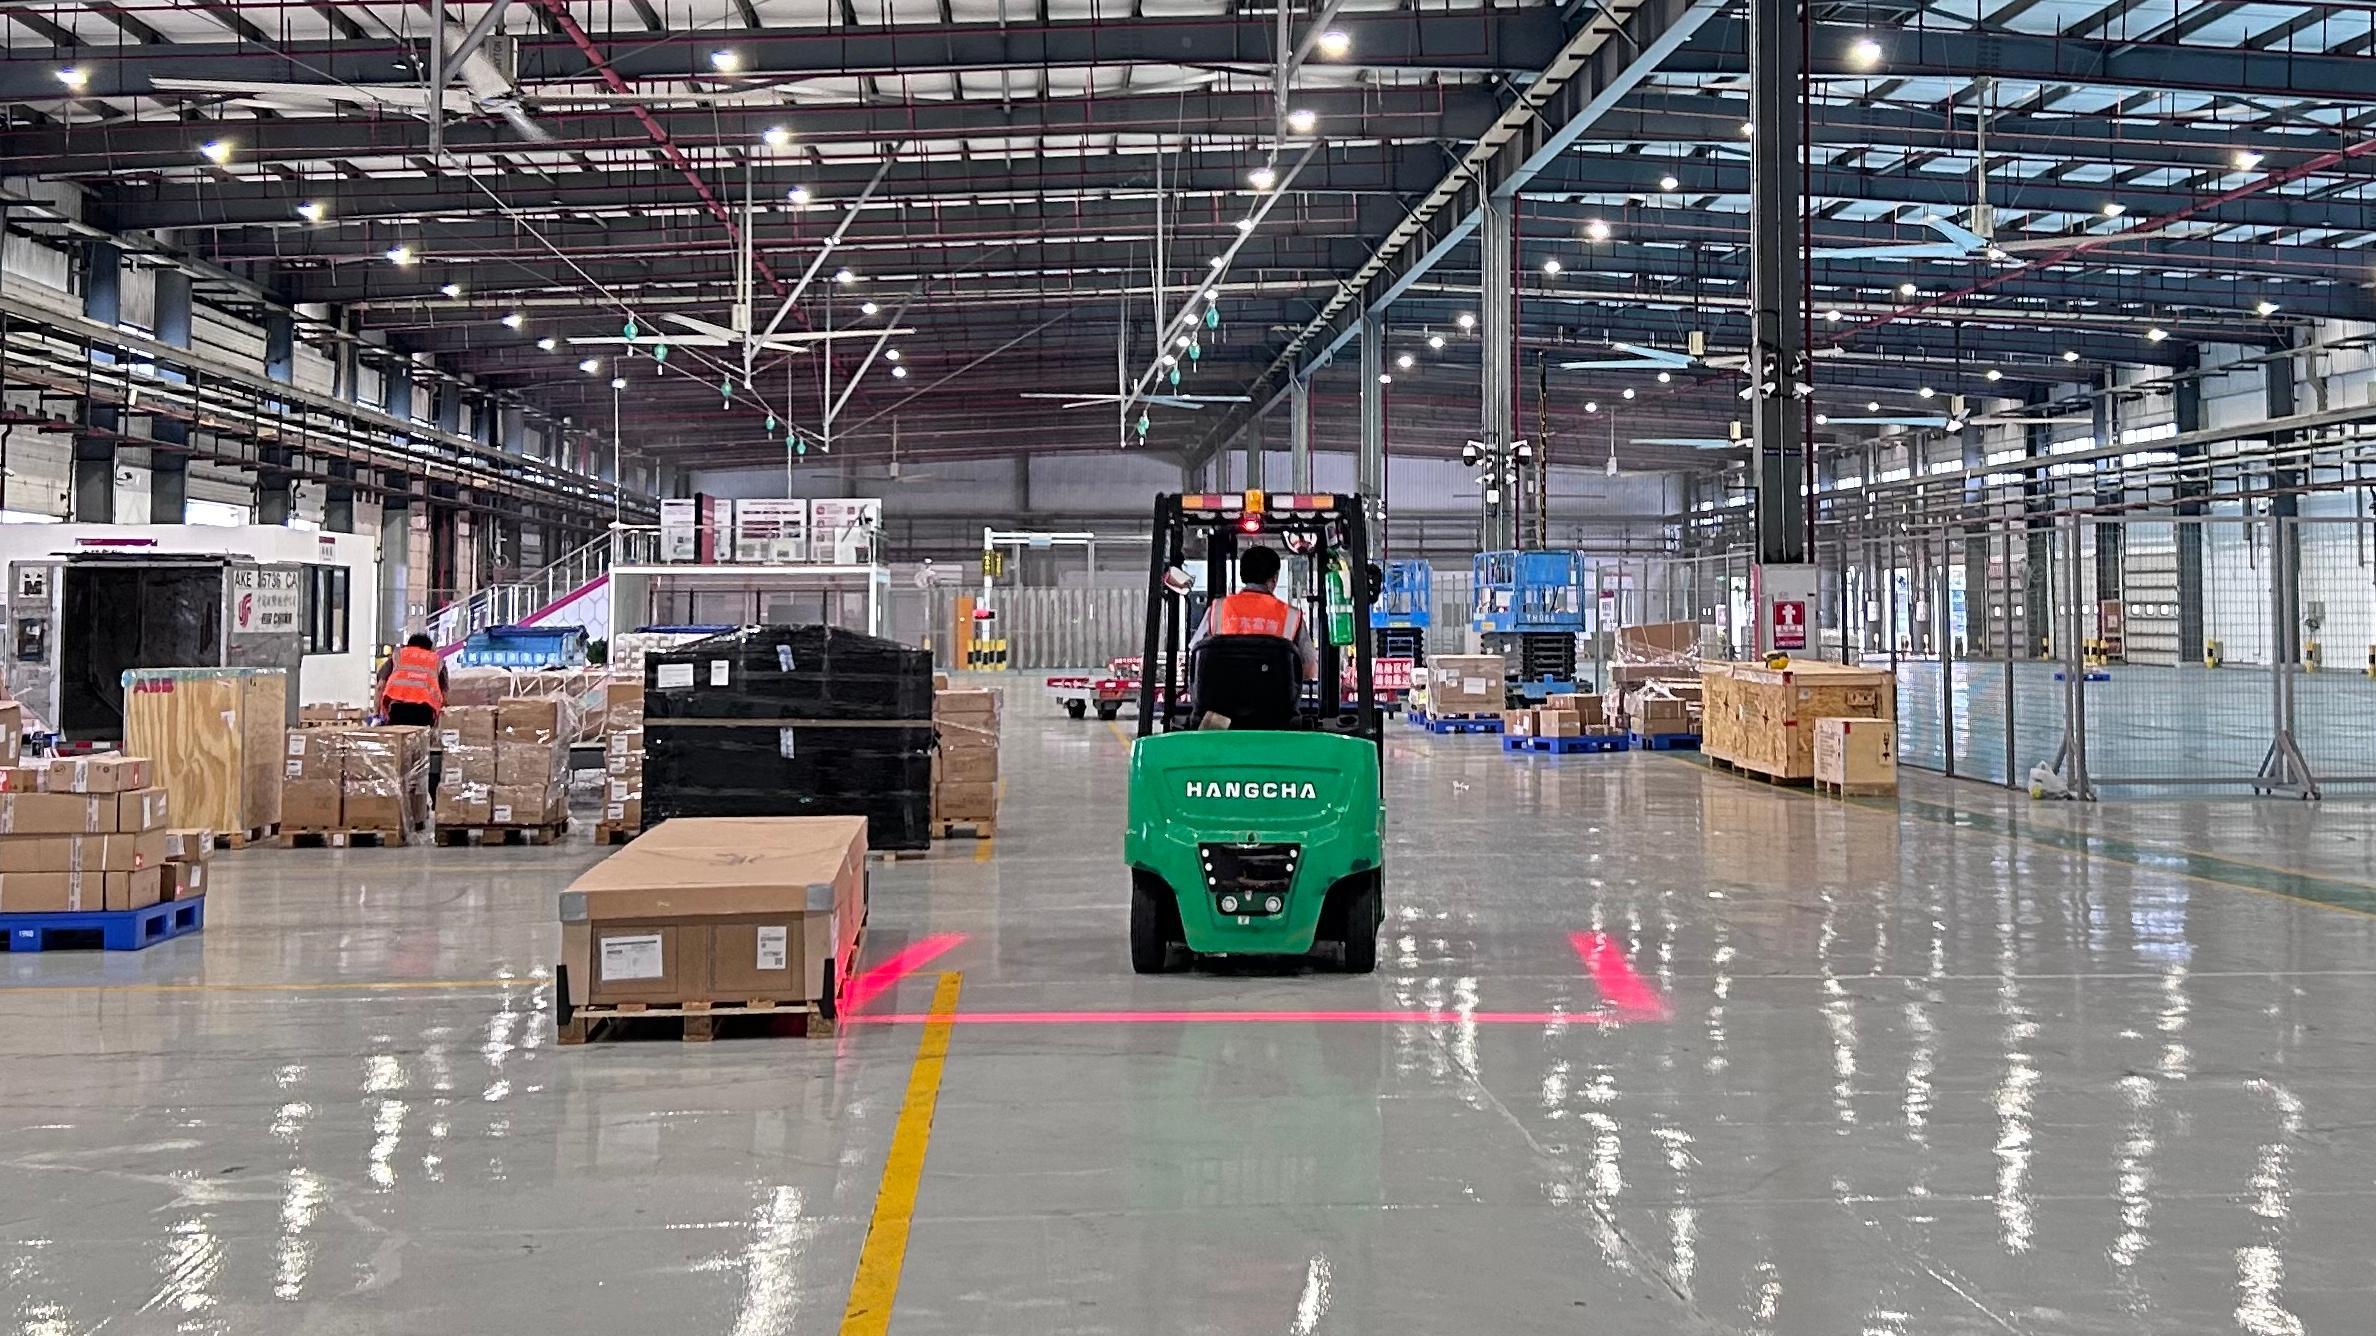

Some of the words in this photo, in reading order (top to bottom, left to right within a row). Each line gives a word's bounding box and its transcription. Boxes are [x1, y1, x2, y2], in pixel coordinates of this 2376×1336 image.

[235, 571, 252, 588] AKE
[286, 572, 298, 588] CA
[133, 677, 175, 694] ABB
[1186, 781, 1317, 799] HANGCHA
